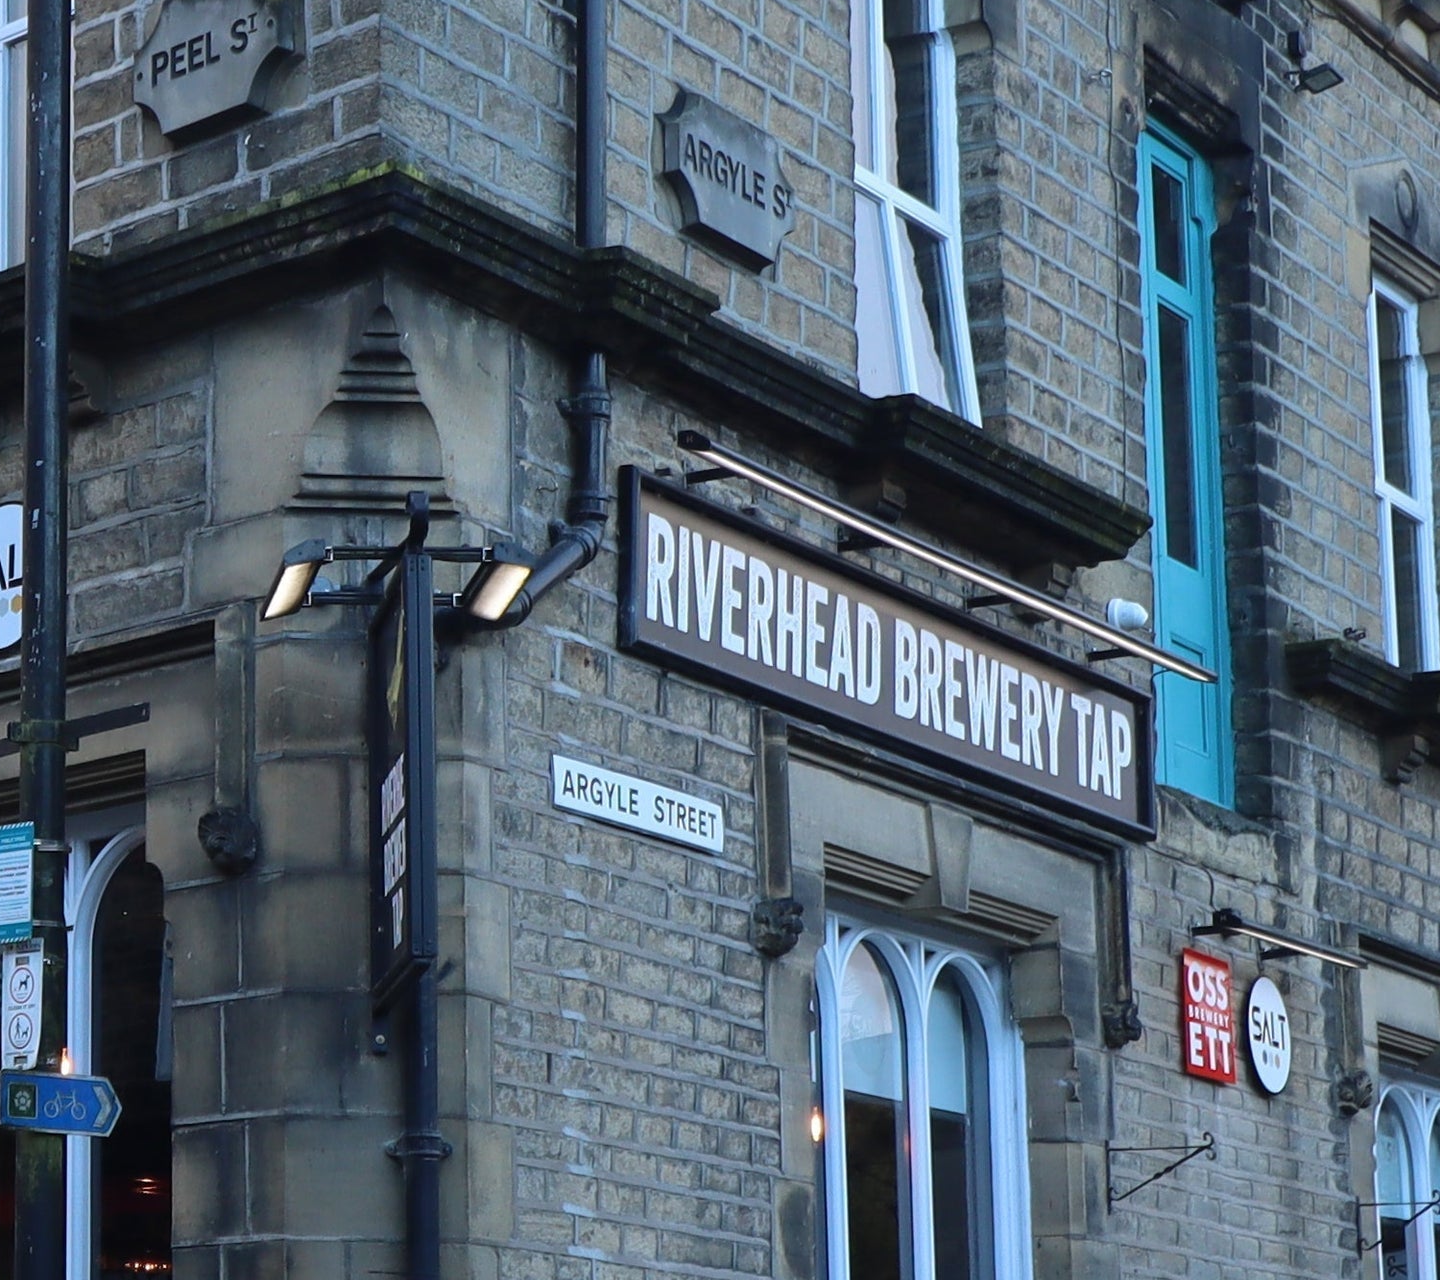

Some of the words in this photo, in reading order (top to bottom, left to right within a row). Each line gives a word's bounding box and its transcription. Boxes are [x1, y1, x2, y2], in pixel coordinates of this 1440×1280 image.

[152, 31, 220, 88] PEEL
[684, 133, 766, 210] ARGYLE
[646, 513, 883, 704] RIVERHEAD
[894, 617, 1062, 776] BREWERY
[1072, 692, 1132, 801] TAP
[562, 763, 642, 826] ARGYLE
[652, 788, 719, 843] STREET
[1187, 962, 1230, 1011] OSS
[1188, 1004, 1230, 1027] BREWERY
[1252, 1006, 1287, 1056] SALT
[1189, 1020, 1233, 1076] ETT
